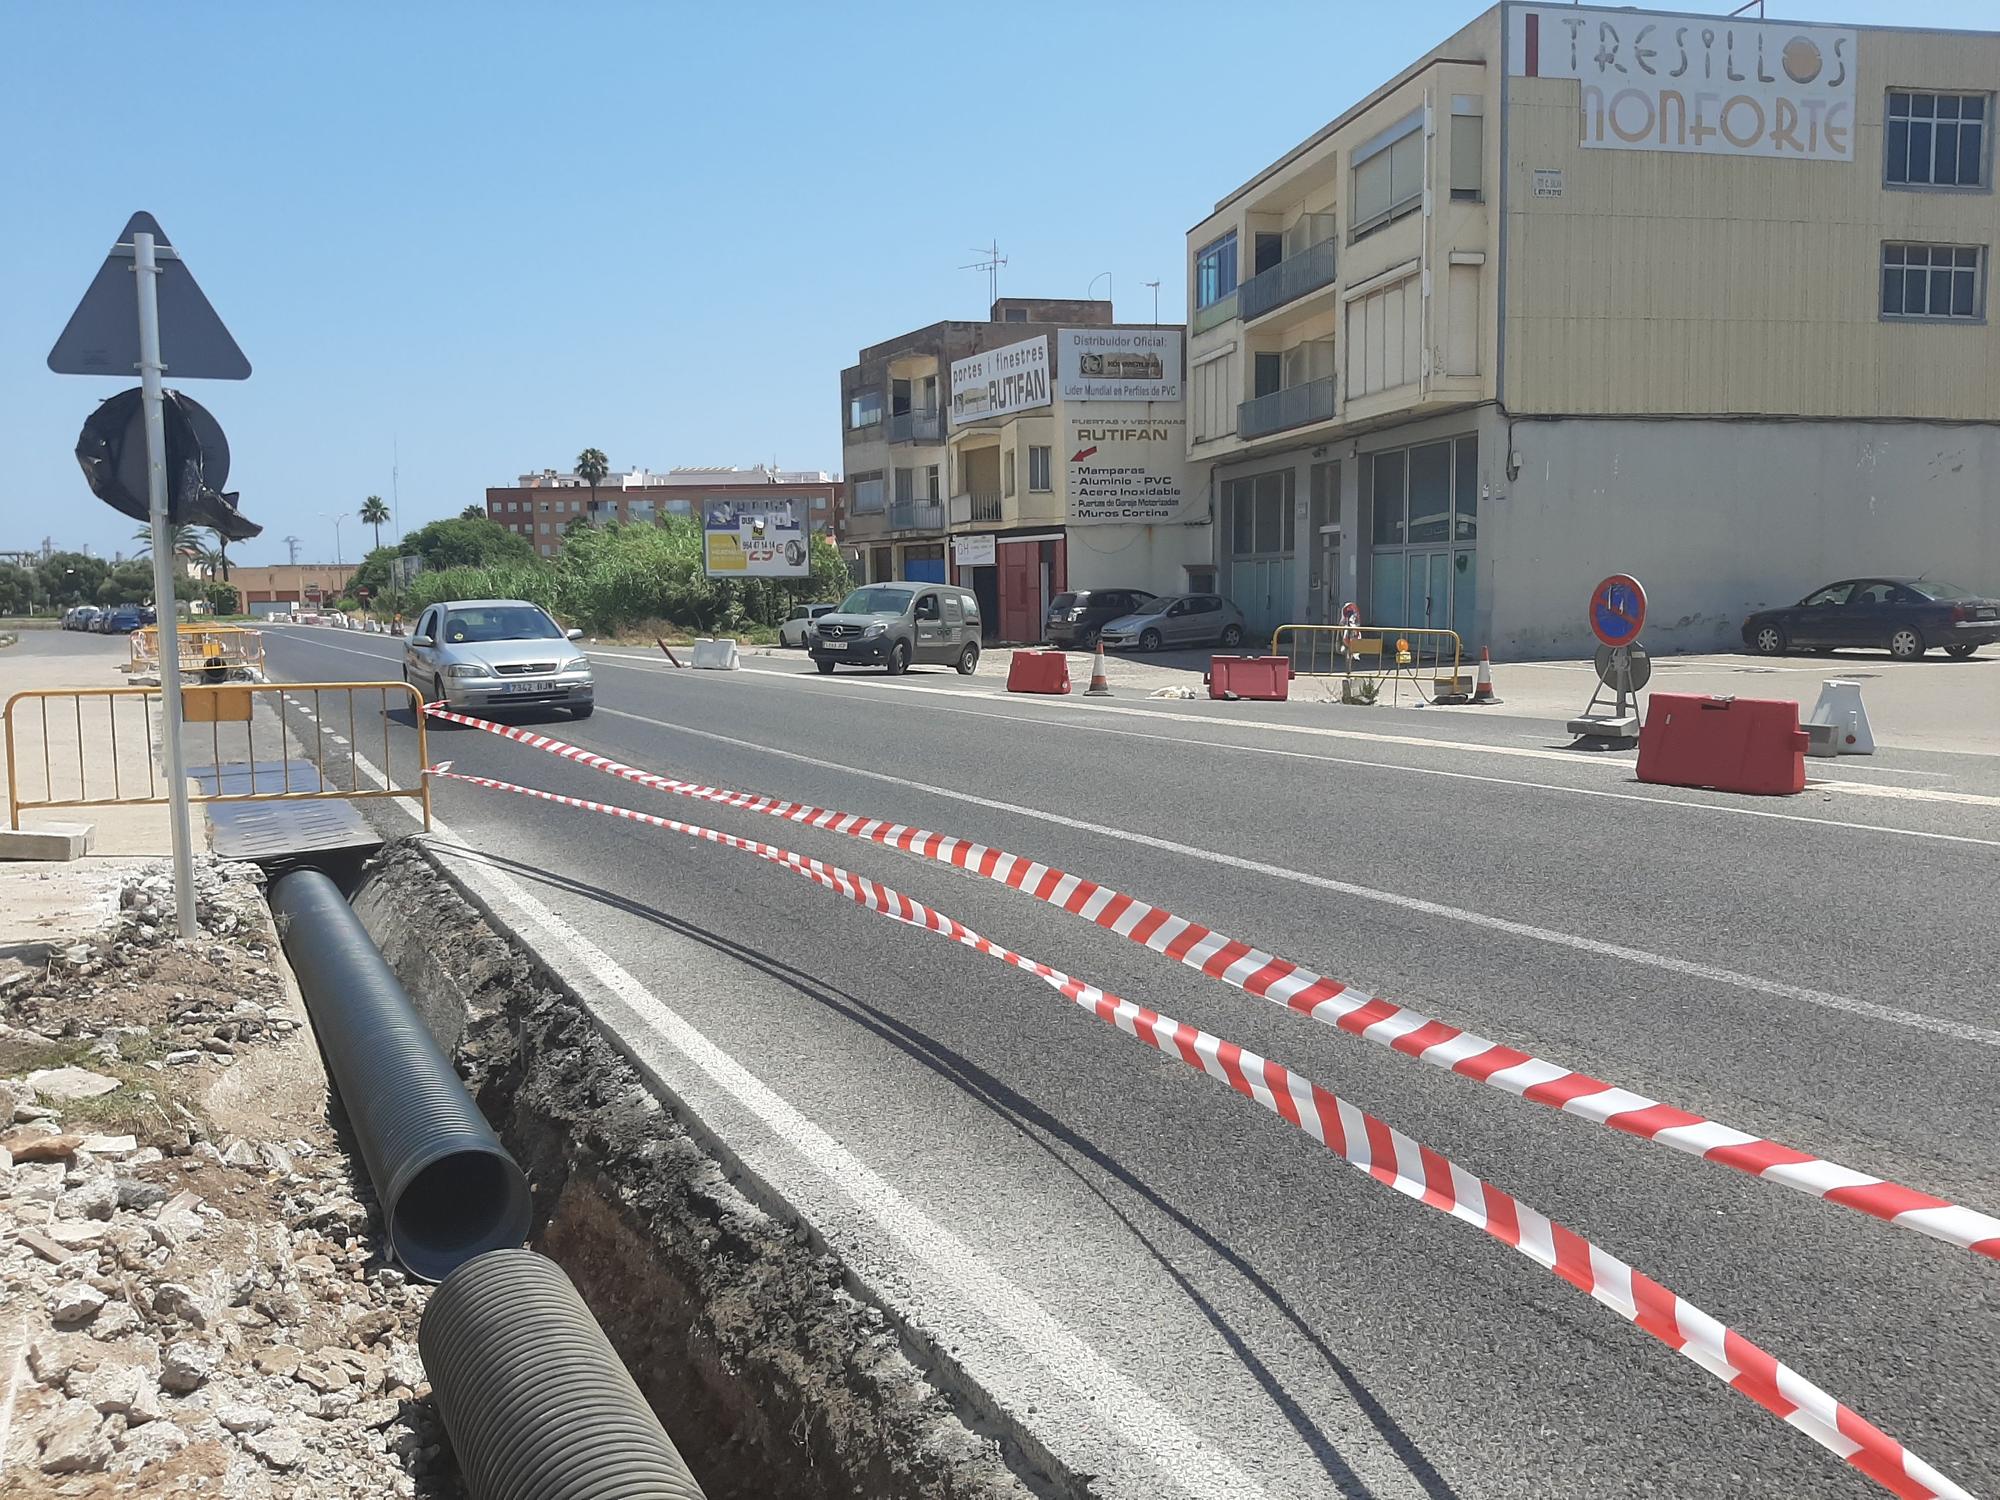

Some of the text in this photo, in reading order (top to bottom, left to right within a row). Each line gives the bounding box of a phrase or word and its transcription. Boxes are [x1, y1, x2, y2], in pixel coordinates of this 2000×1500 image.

[1561, 18, 1847, 88] TRESILLOS
[1073, 335, 1167, 347] Distribuidor Oficial:
[953, 363, 982, 388] portes
[996, 345, 1044, 371] finestres
[989, 367, 1046, 411] RUTIFAN
[1084, 385, 1112, 396] Mundial
[1124, 386, 1149, 397] Perfiles
[1161, 386, 1176, 397] PVC
[1077, 429, 1168, 441] RUTIFAN
[1078, 467, 1145, 477] Mamparas
[1079, 476, 1172, 486] Aluminio PVC
[1079, 487, 1181, 497] Acero Inoxidable
[1078, 508, 1169, 518] Muros Cortina
